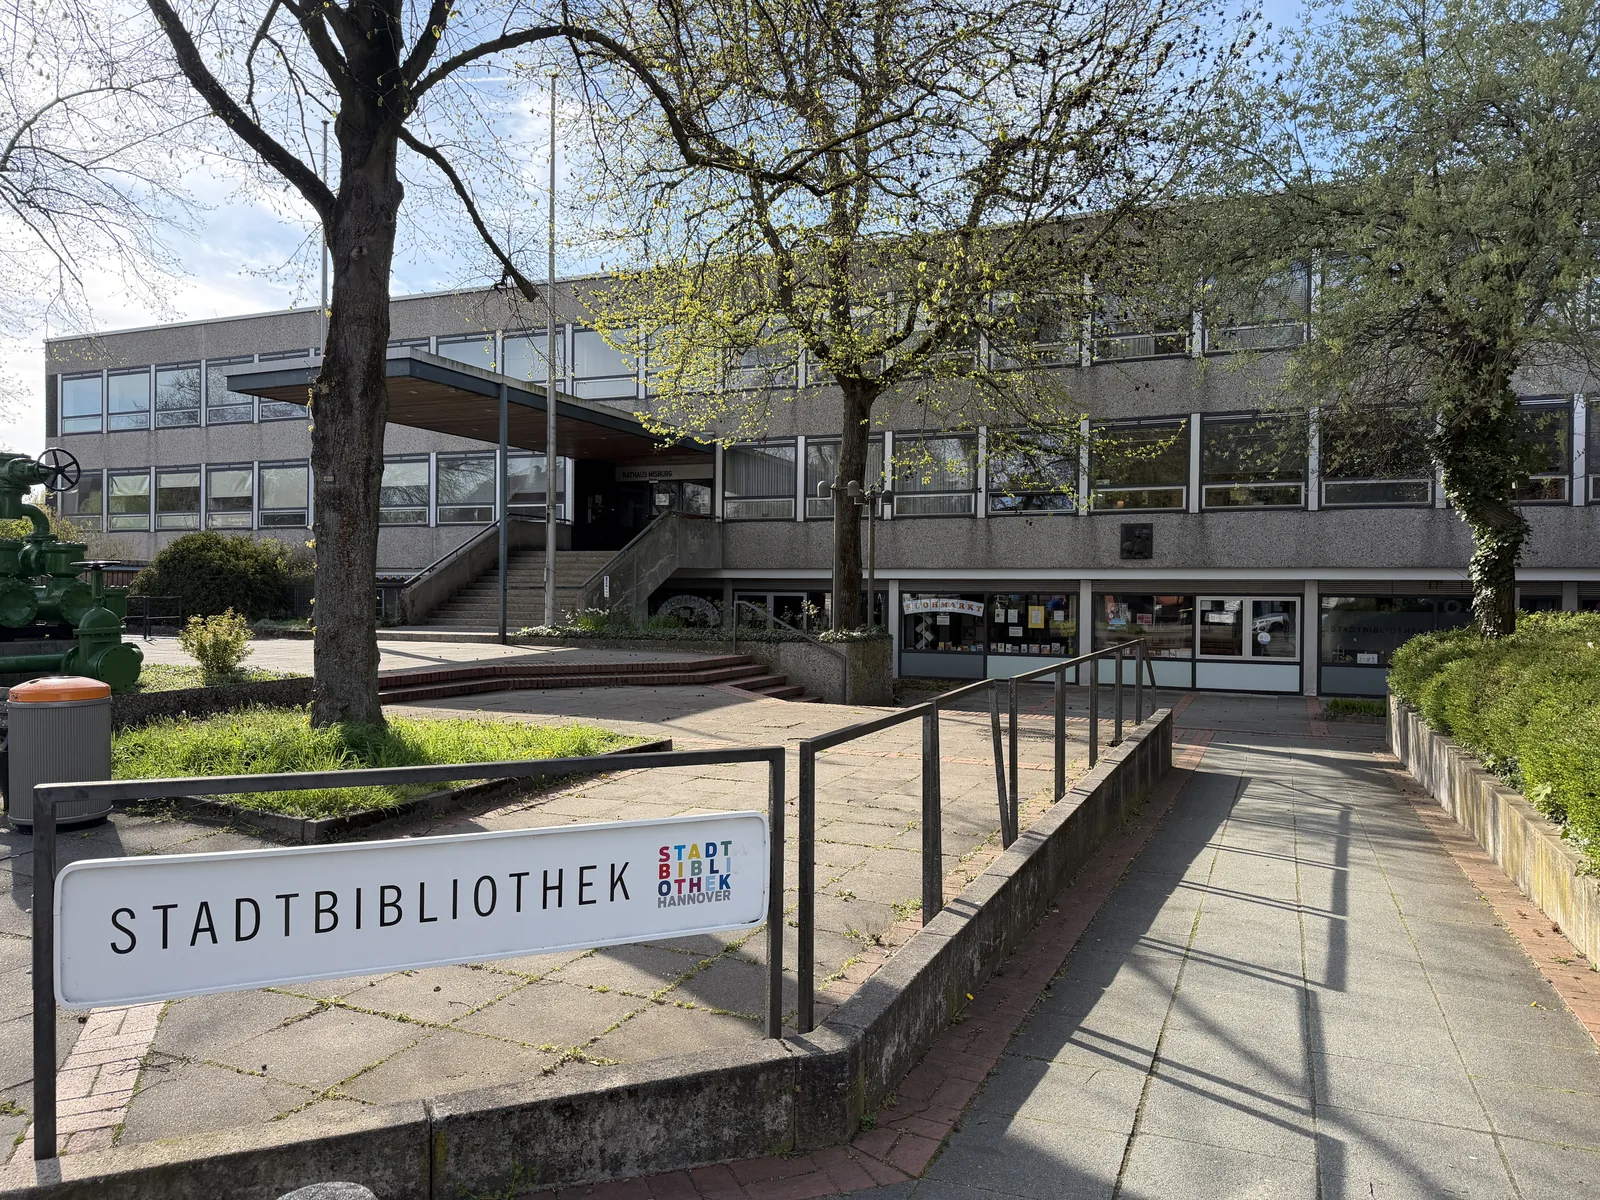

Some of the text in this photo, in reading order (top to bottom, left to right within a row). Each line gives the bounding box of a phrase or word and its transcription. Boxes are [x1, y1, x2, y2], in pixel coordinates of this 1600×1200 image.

[622, 470, 672, 479] RATHAUS MISBURG
[904, 600, 983, 613] FLOHMARKT
[658, 840, 732, 863] STADT
[658, 857, 731, 880] BIBLI
[657, 874, 731, 897] OTHEK
[110, 861, 631, 955] STADTBIBLIOTHEK
[657, 889, 731, 909] HANNOVER
